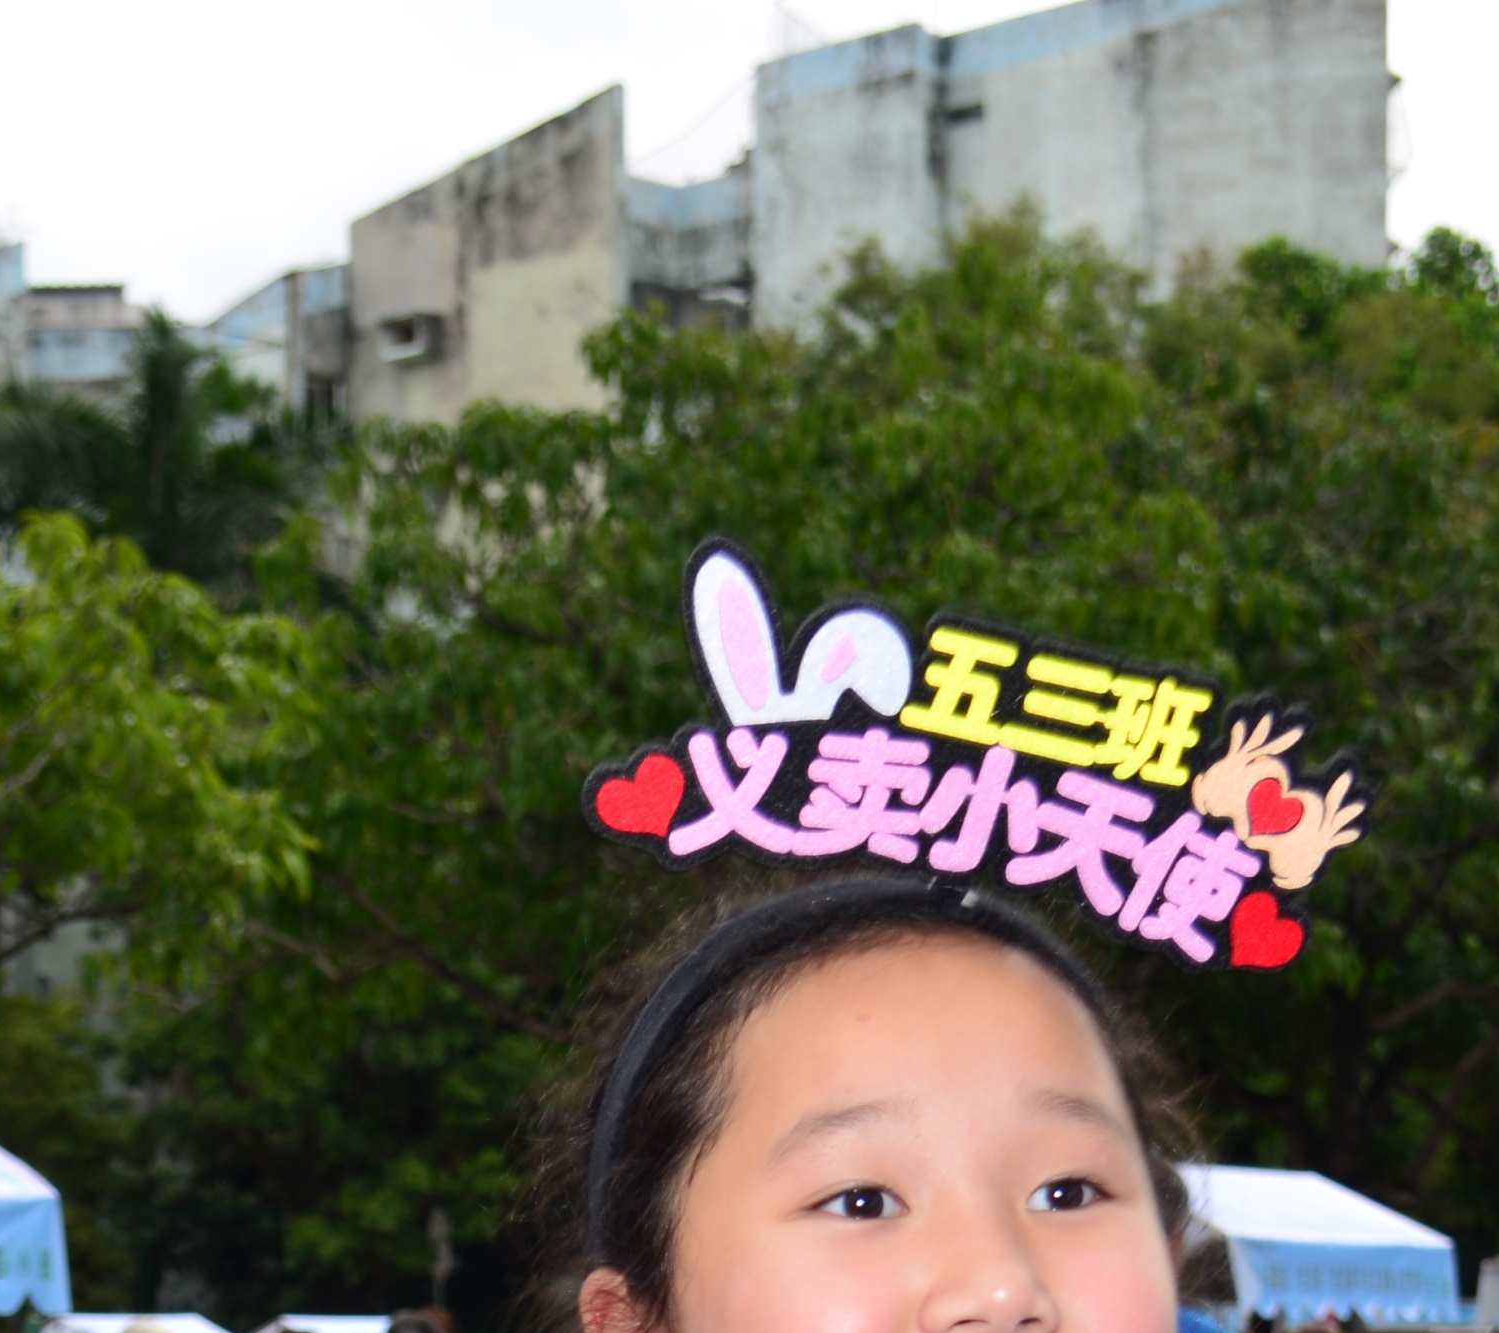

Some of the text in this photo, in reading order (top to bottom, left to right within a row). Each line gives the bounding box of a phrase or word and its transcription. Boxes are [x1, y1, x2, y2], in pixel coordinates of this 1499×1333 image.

[900, 626, 1212, 788] 五三班
[667, 726, 1262, 964] 义卖小天使
